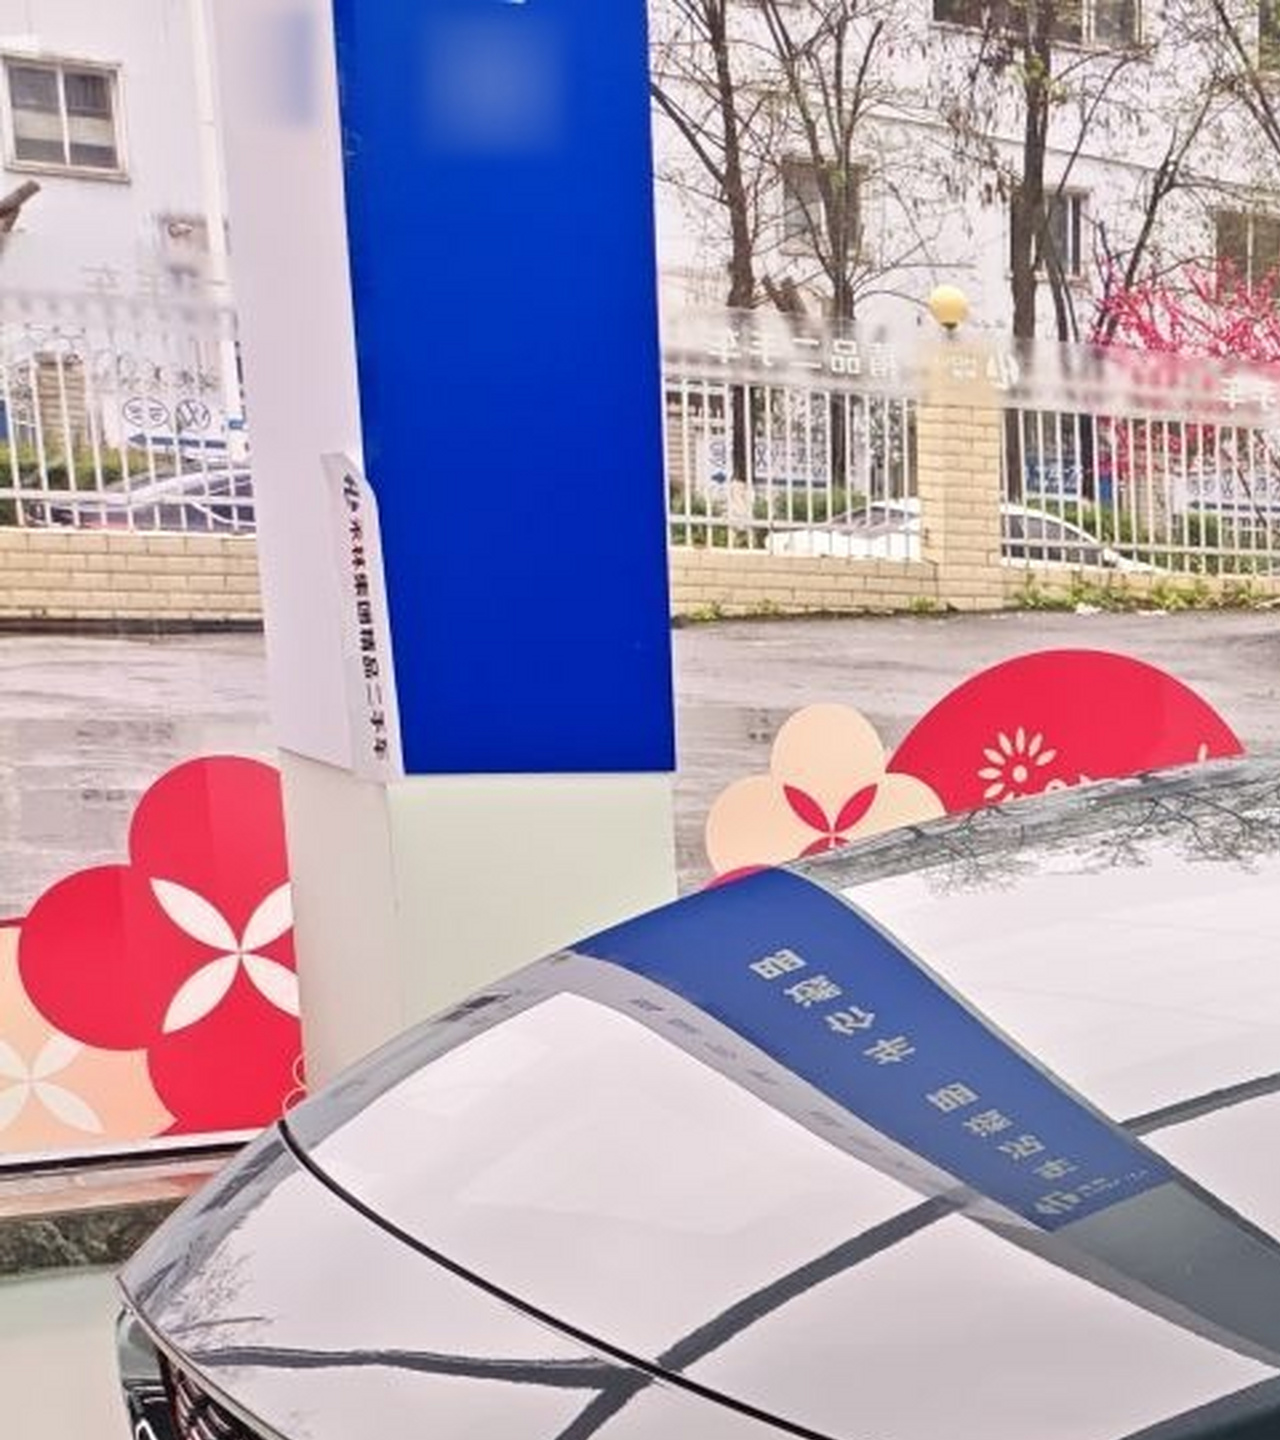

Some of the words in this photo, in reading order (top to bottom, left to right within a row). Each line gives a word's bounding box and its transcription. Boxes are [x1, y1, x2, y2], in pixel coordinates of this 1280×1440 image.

[348, 518, 390, 762] 禾林集团精品二手车
